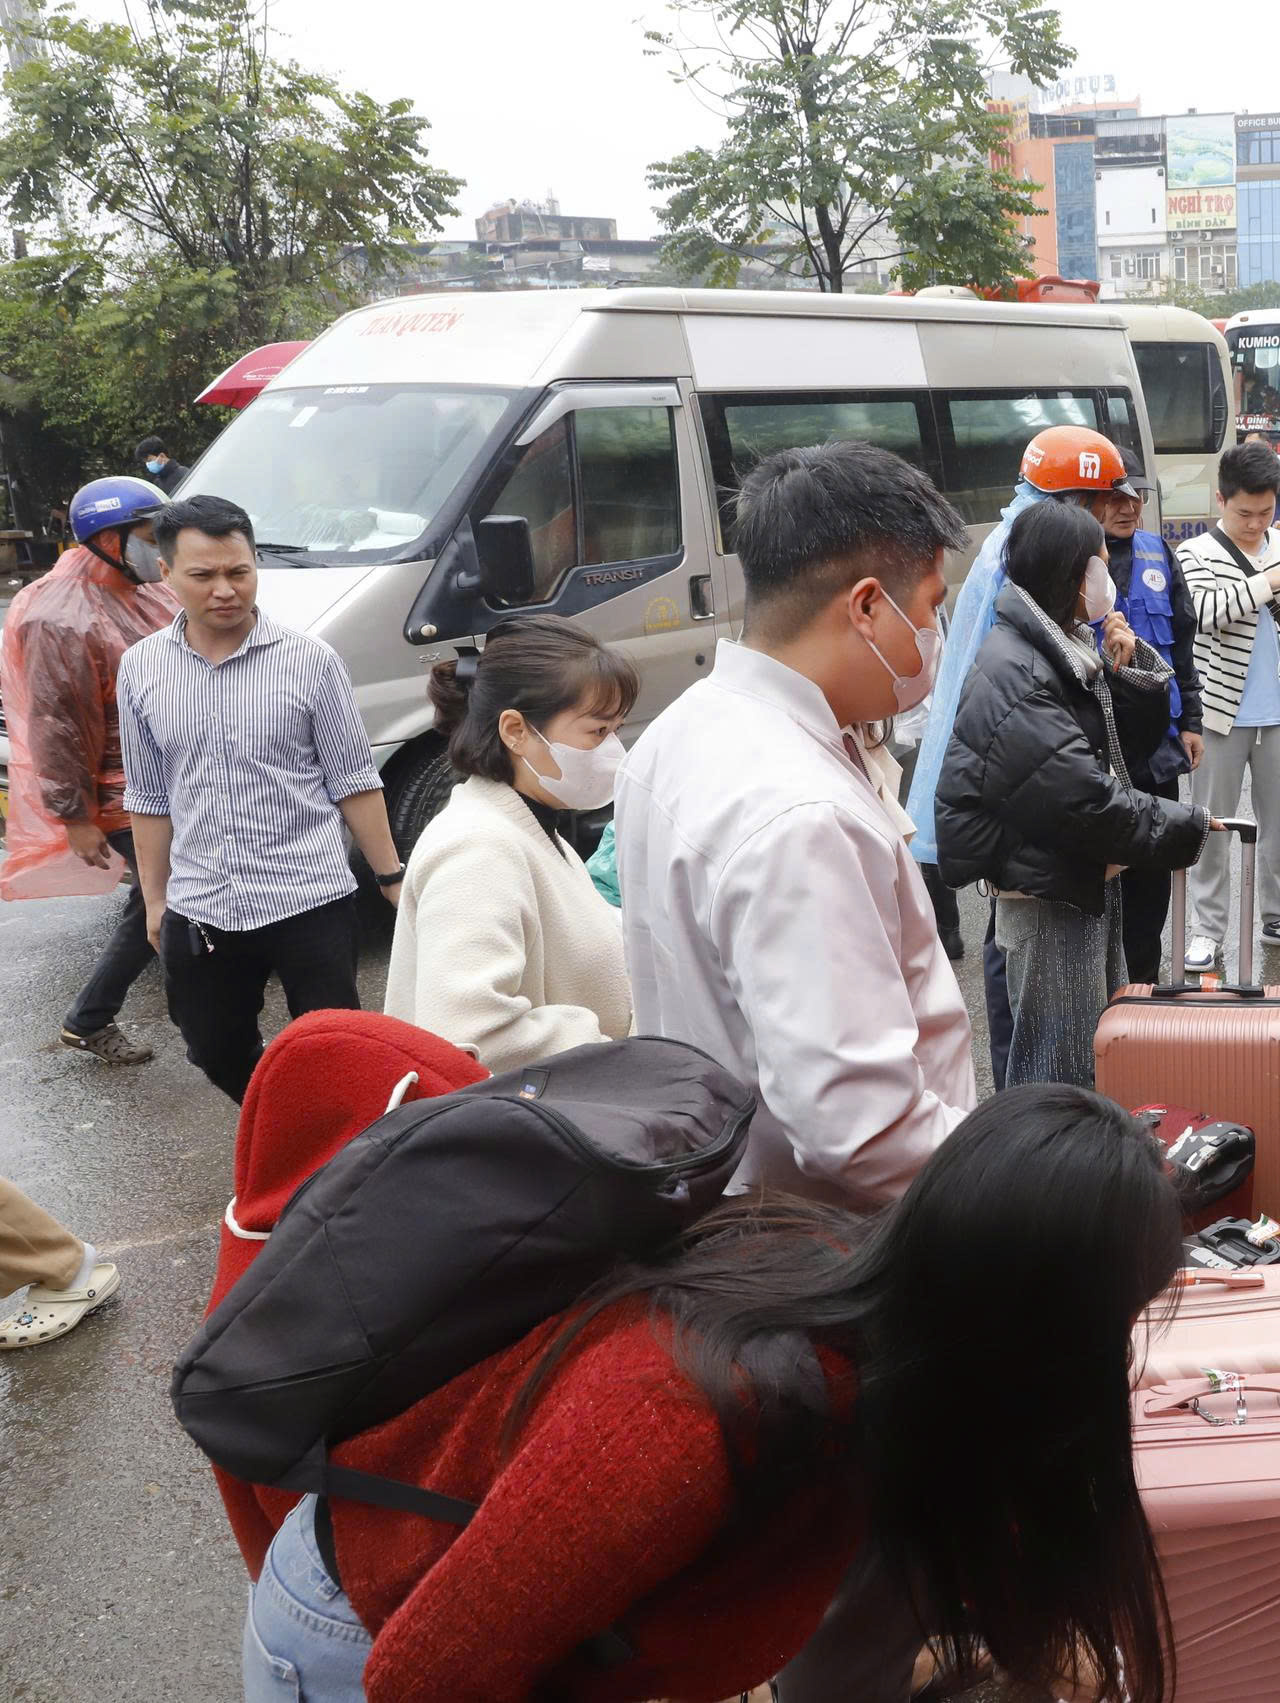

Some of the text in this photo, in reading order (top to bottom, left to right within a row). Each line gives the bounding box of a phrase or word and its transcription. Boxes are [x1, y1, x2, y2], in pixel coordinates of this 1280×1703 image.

[1237, 118, 1266, 128] OFFICE
[1238, 335, 1280, 349] KUMHO
[583, 567, 645, 585] TRANSIT
